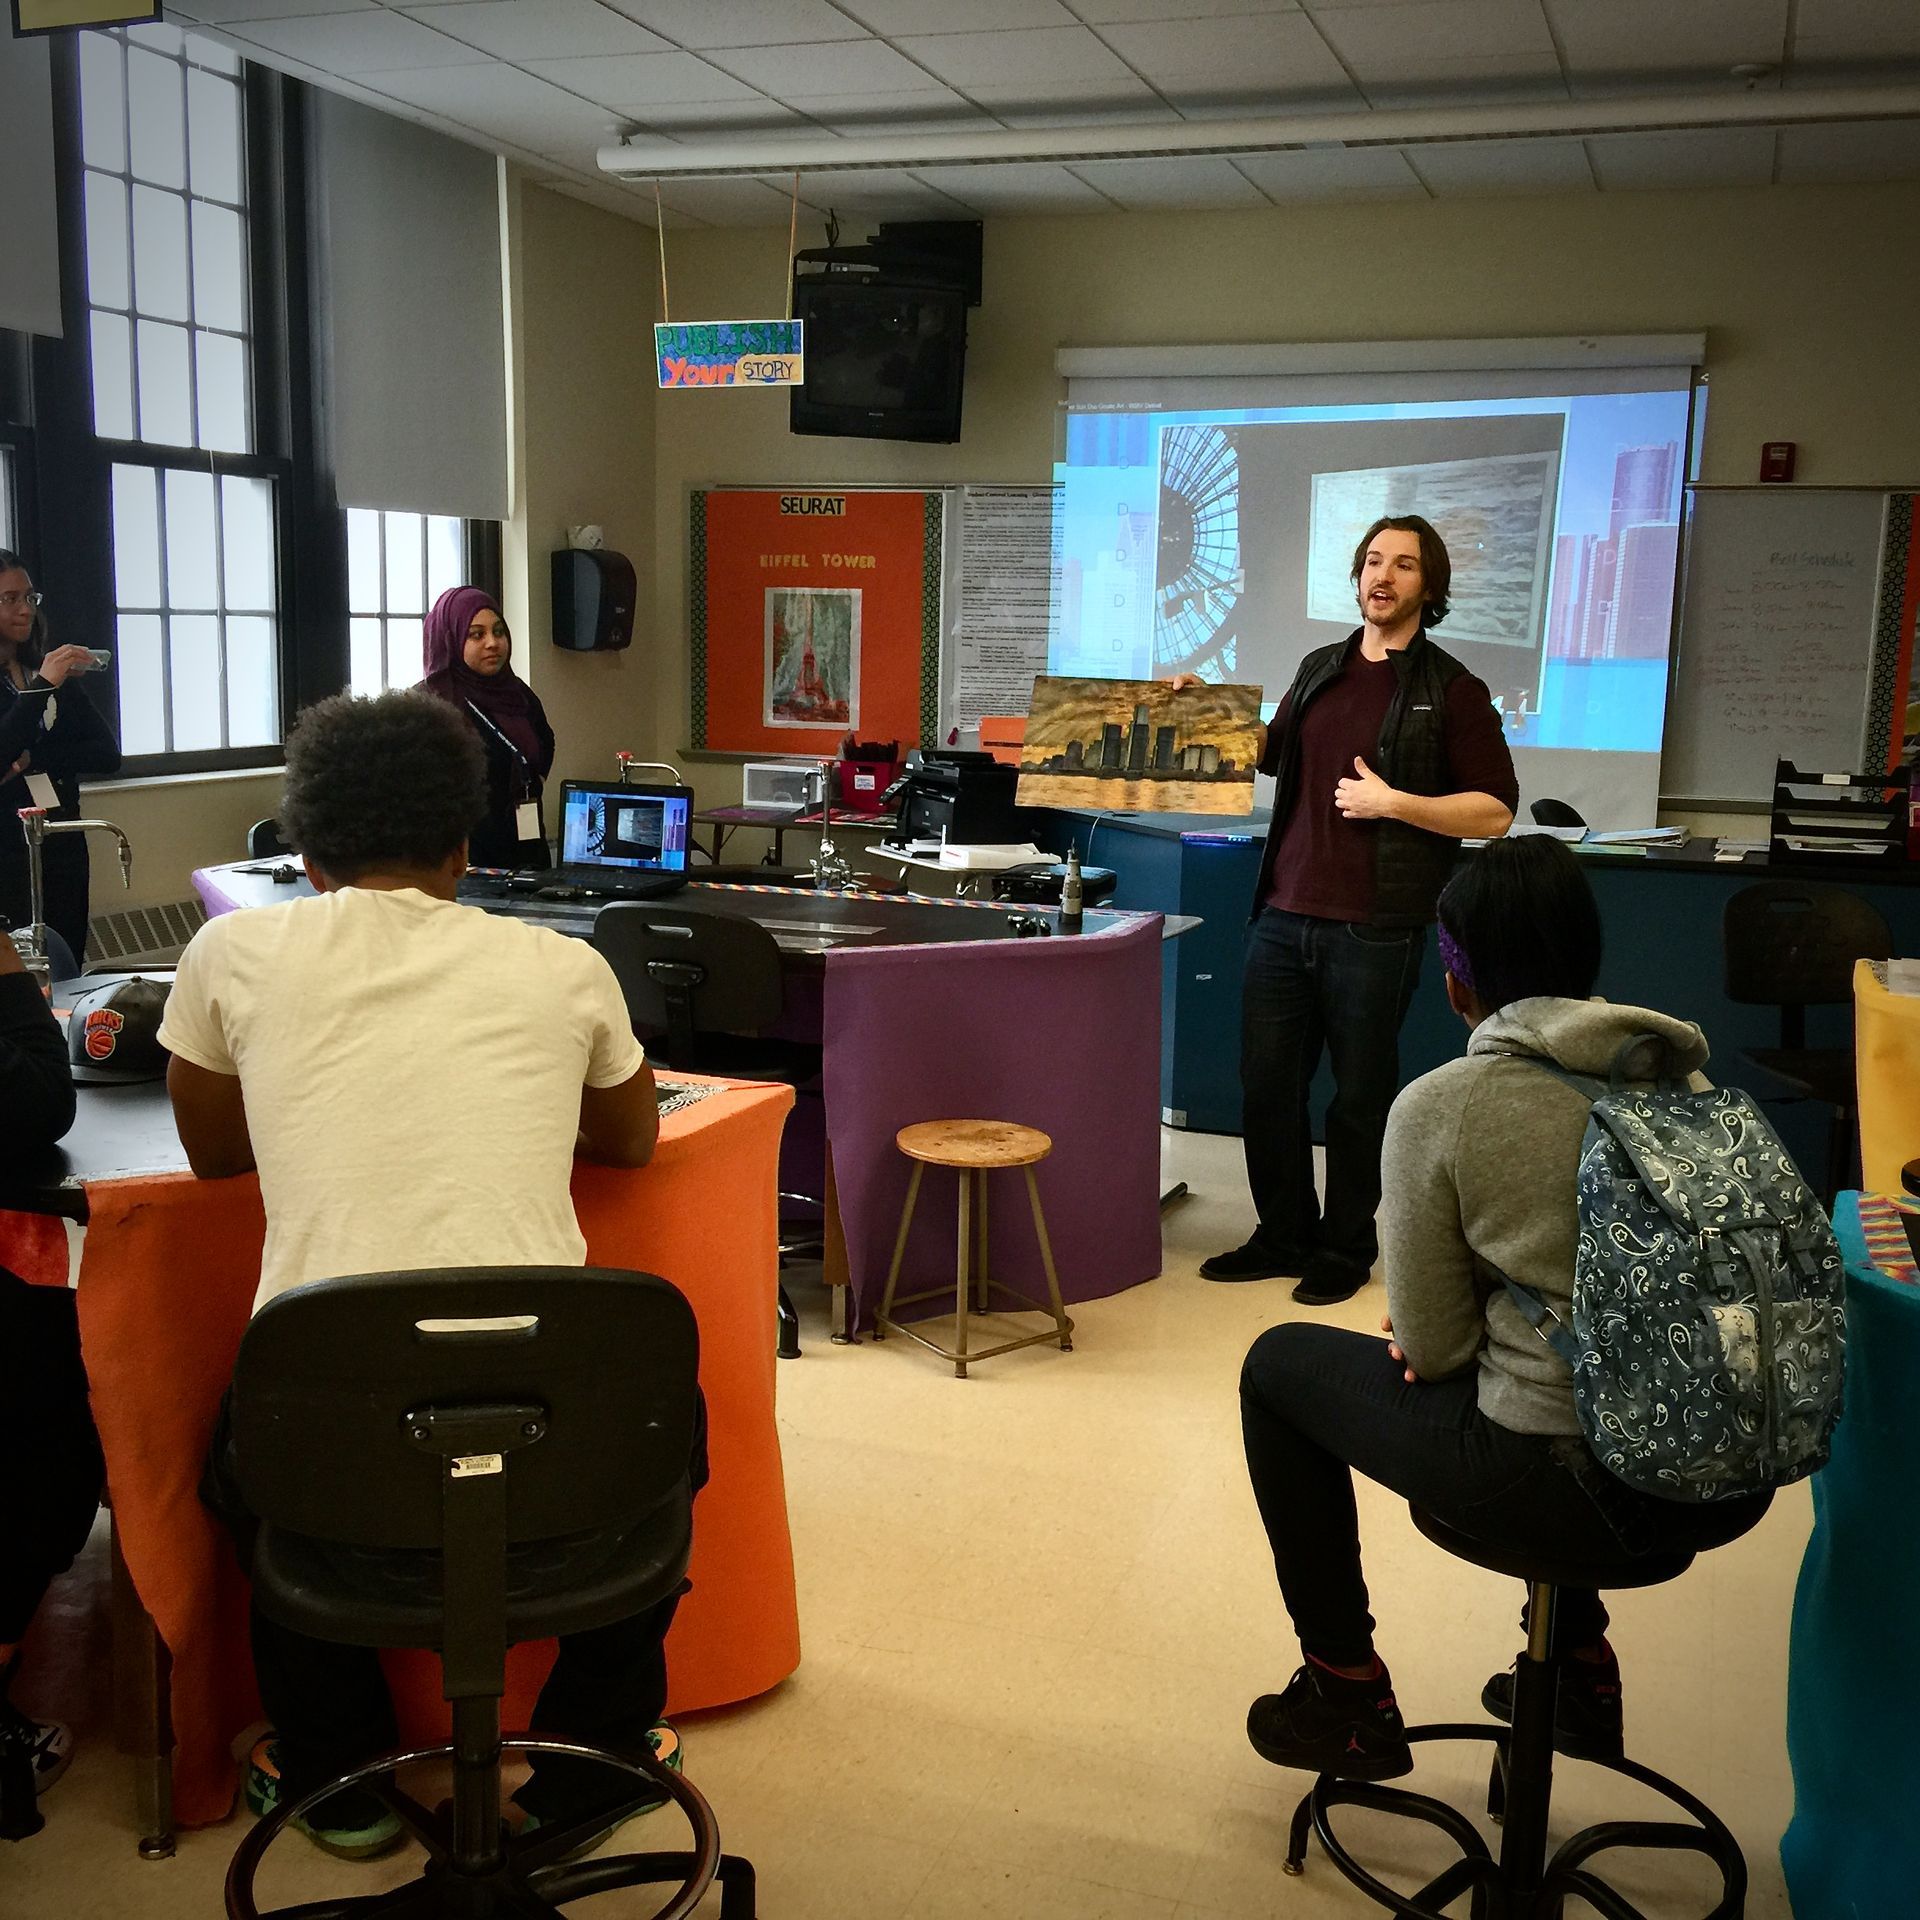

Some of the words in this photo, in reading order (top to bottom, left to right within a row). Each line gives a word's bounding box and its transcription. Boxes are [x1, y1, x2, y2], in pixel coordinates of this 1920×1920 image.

[657, 324, 793, 356] PUBLISH
[663, 357, 735, 385] Your
[743, 361, 793, 378] STORY
[780, 497, 845, 514] SEURAT
[760, 554, 809, 568] EIFFEL
[822, 553, 876, 569] TOWER
